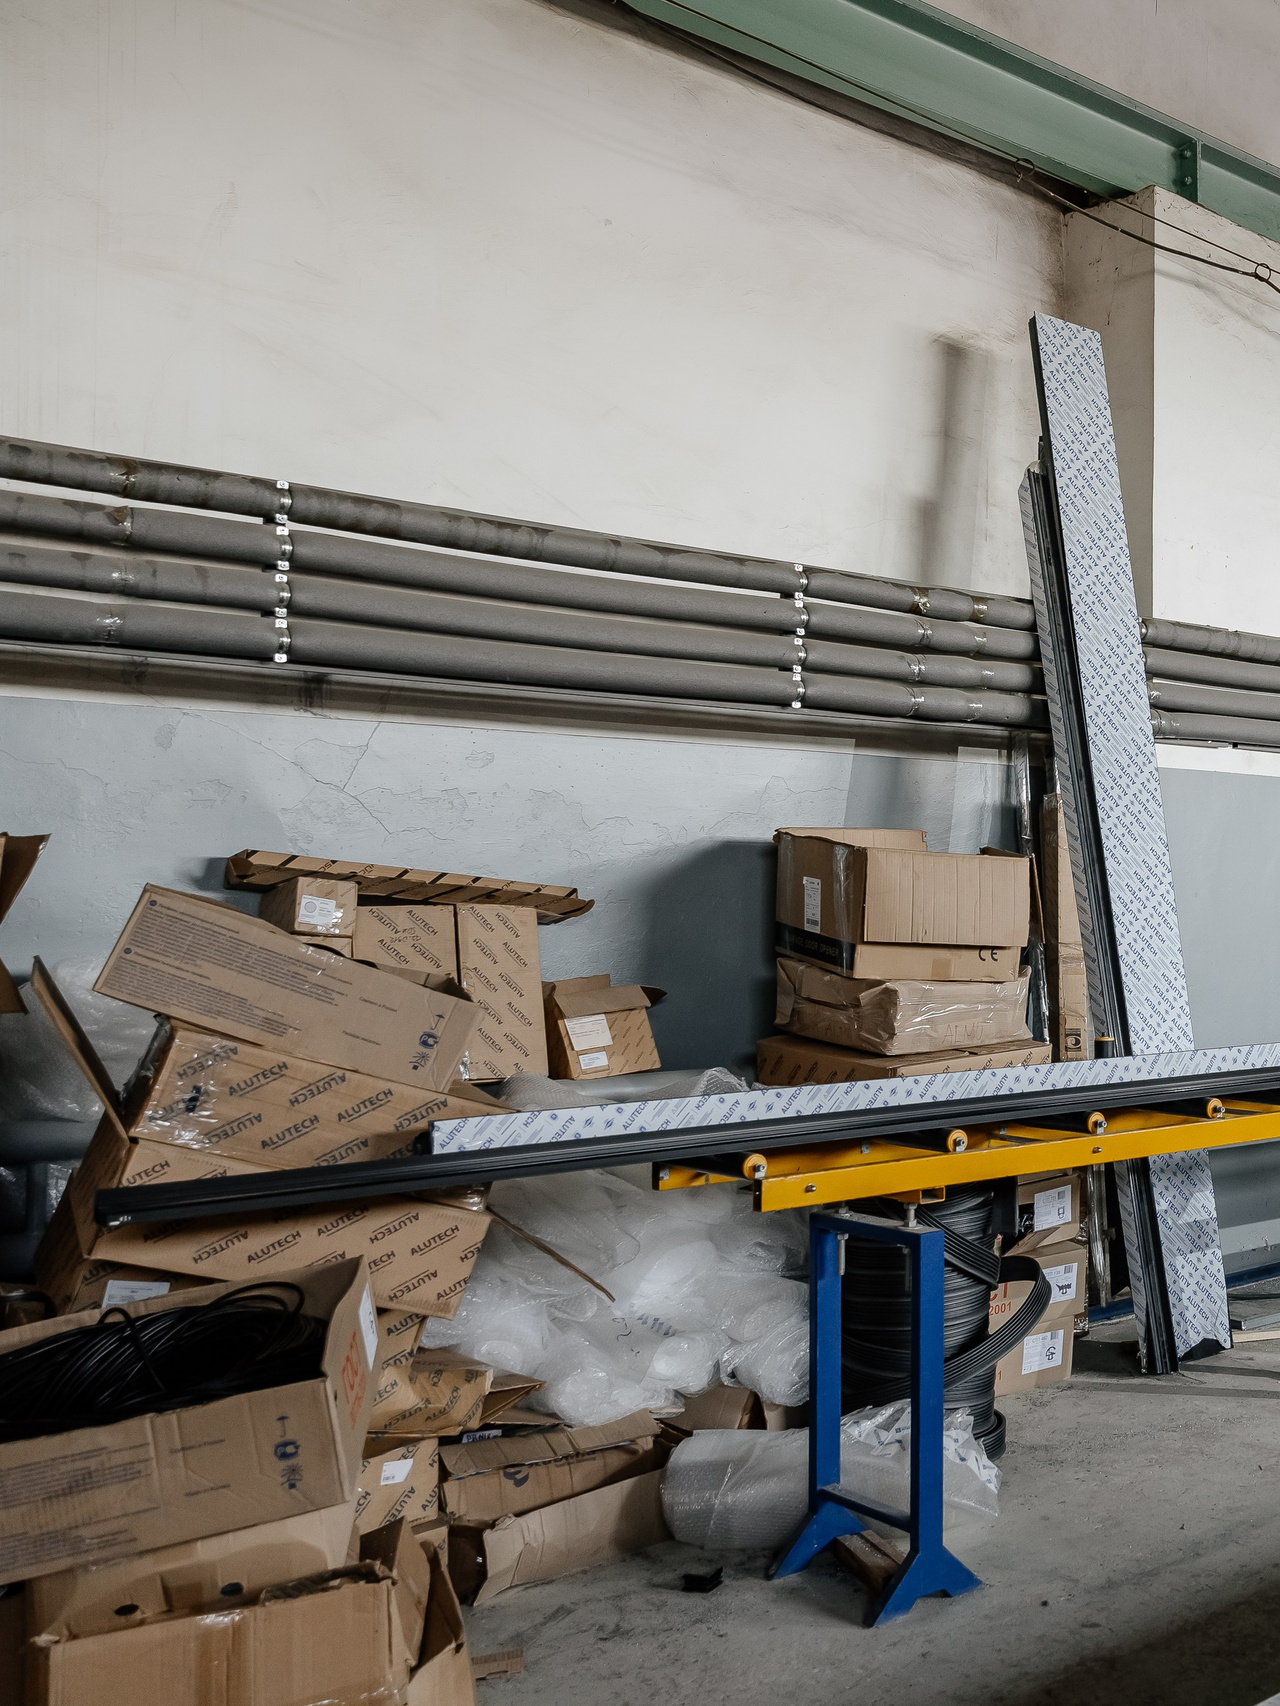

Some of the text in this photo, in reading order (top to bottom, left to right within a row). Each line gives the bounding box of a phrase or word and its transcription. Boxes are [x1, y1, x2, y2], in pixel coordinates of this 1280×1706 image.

[1040, 326, 1062, 355] ALUTECH
[1048, 318, 1070, 347] ALUTECH
[1039, 344, 1053, 363] ALUT
[1074, 346, 1096, 375] ALUTECH
[1083, 339, 1104, 367] ALUTECH
[1058, 362, 1080, 391] ALUTECH
[1066, 354, 1088, 383] ALUTECH
[1050, 370, 1071, 399] ALUTECH
[1083, 407, 1105, 435] ALUTECH
[1091, 399, 1113, 426] ALUTECH
[1066, 423, 1088, 452] ALUTECH
[1075, 415, 1096, 443] ALUTECH
[1058, 432, 1080, 461] ALUTECH
[1101, 442, 1118, 466] ALUTEC
[1084, 460, 1106, 488] ALUTECH
[1093, 451, 1114, 479] ALUTECH
[1068, 477, 1090, 505] ALUTECH
[1076, 468, 1098, 496] ALUTECH
[1059, 486, 1081, 515] ALUTECH
[1110, 503, 1126, 525] UTECH
[1060, 505, 1073, 524] TECH
[1101, 512, 1123, 540] ALUTECH
[1084, 529, 1107, 557] ALUTECH
[1093, 520, 1115, 548] ALUTECH
[1068, 548, 1090, 577] ALUTECH
[1076, 539, 1098, 567] ALUTECH
[1103, 565, 1125, 593] ALUTECH
[1111, 555, 1133, 583] ALUTECH
[1086, 584, 1108, 612] ALUTECH
[1094, 575, 1116, 602] ALUTECH
[1078, 594, 1100, 622] ALUTECH
[1103, 638, 1125, 665] ALUTECH
[1112, 628, 1134, 655] ALUTECH
[1087, 658, 1109, 686] ALUTECH
[1095, 648, 1117, 676] ALUTECH
[1080, 672, 1101, 697] ALUTEC
[1113, 684, 1135, 711] ALUTECH
[1122, 673, 1143, 700] ALUTECH
[1097, 704, 1119, 732] ALUTECH
[1105, 694, 1127, 722] ALUTECH
[1088, 715, 1110, 743] ALUTECH
[1139, 727, 1155, 747] UTECH
[1088, 736, 1102, 754] TECH
[1131, 737, 1152, 764] ALUTECH
[1114, 757, 1136, 785] ALUTECH
[1123, 747, 1144, 774] ALUTECH
[1097, 780, 1119, 808] ALUTECH
[1106, 769, 1128, 797] ALUTECH
[1141, 782, 1162, 808] ALUTECH
[1124, 804, 1146, 831] ALUTECH
[1132, 793, 1154, 820] ALUTECH
[1108, 827, 1130, 855] ALUTECH
[1116, 816, 1138, 843] ALUTECH
[1103, 842, 1121, 866] LUTECH
[1150, 847, 1171, 873] ALUTECH
[1133, 870, 1155, 897] ALUTECH
[1142, 859, 1164, 885] ALUTECH
[1117, 894, 1139, 922] ALUTECH
[1125, 882, 1147, 909] ALUTECH
[368, 908, 400, 935] ALUTECH
[407, 910, 438, 936] ALUTECH
[469, 906, 495, 932] ALUTECH
[495, 913, 520, 938] ALUTECH
[1112, 910, 1131, 935] ALUTEC
[1143, 917, 1166, 945] ALUTECH
[1152, 905, 1174, 932] ALUTECH
[378, 938, 410, 966] ALUTECH
[411, 943, 442, 969] ALUTECH
[473, 939, 498, 965] ALUTECH
[503, 942, 528, 967] ALUTECH
[1127, 942, 1149, 969] ALUTECH
[1135, 929, 1158, 956] ALUTECH
[472, 966, 498, 992] ALUTECH
[1119, 955, 1141, 982] ALUTECH
[1169, 960, 1186, 980] UTECH
[498, 972, 524, 998] ALUTECH
[1153, 984, 1175, 1010] ALUTECH
[1161, 972, 1183, 999] ALUTECH
[507, 1002, 533, 1027] ALUTECH
[1136, 1010, 1159, 1036] ALUTECH
[1145, 997, 1167, 1023] ALUTECH
[477, 1027, 503, 1053] ALUTECH
[1163, 1031, 1182, 1052] ALUTEC
[1171, 1018, 1193, 1044] ALUTECH
[504, 1033, 530, 1057] ALUTECH
[229, 1061, 288, 1096] ALUTECH
[919, 1074, 938, 1099] ALUTECH
[1040, 1063, 1056, 1087] ALUTECH
[289, 1072, 347, 1107] ALUTECH
[781, 1087, 803, 1114] ALUTECH
[865, 1085, 883, 1109] ALUTEC
[337, 1088, 394, 1122] ALUTECH
[394, 1098, 449, 1131] ALUTECH
[623, 1100, 649, 1131] ALUTECH
[719, 1100, 741, 1124] ALUTEC
[261, 1115, 320, 1149] ALUTECH
[440, 1118, 469, 1150] ALUTECH
[551, 1115, 576, 1142] ALUTEC
[126, 1160, 171, 1186] UTECH
[1175, 1163, 1197, 1188] ALUTECH
[1167, 1176, 1189, 1203] ALUTECH
[1158, 1191, 1181, 1217] ALUTECH
[1201, 1204, 1217, 1223] UTECH
[317, 1205, 369, 1236] ALUTECH
[369, 1213, 420, 1244] ALUTECH
[1157, 1211, 1173, 1232] UTECH
[1193, 1218, 1215, 1244] ALUTECH
[193, 1231, 249, 1264] ALUTECH
[247, 1232, 301, 1264] ALUTECH
[411, 1225, 460, 1256] ALUTECH
[1185, 1231, 1207, 1257] ALUTECH
[1177, 1247, 1199, 1272] ALUTECH
[388, 1270, 437, 1301] ALUTECH
[1168, 1261, 1190, 1287] ALUTECH
[1203, 1265, 1225, 1291] ALUTECH
[436, 1276, 469, 1300] ALUTE
[1195, 1281, 1217, 1306] ALUTECH
[1187, 1296, 1209, 1321] ALUTECH
[386, 1313, 423, 1337] ALUTE
[1179, 1311, 1201, 1336] ALUTECH
